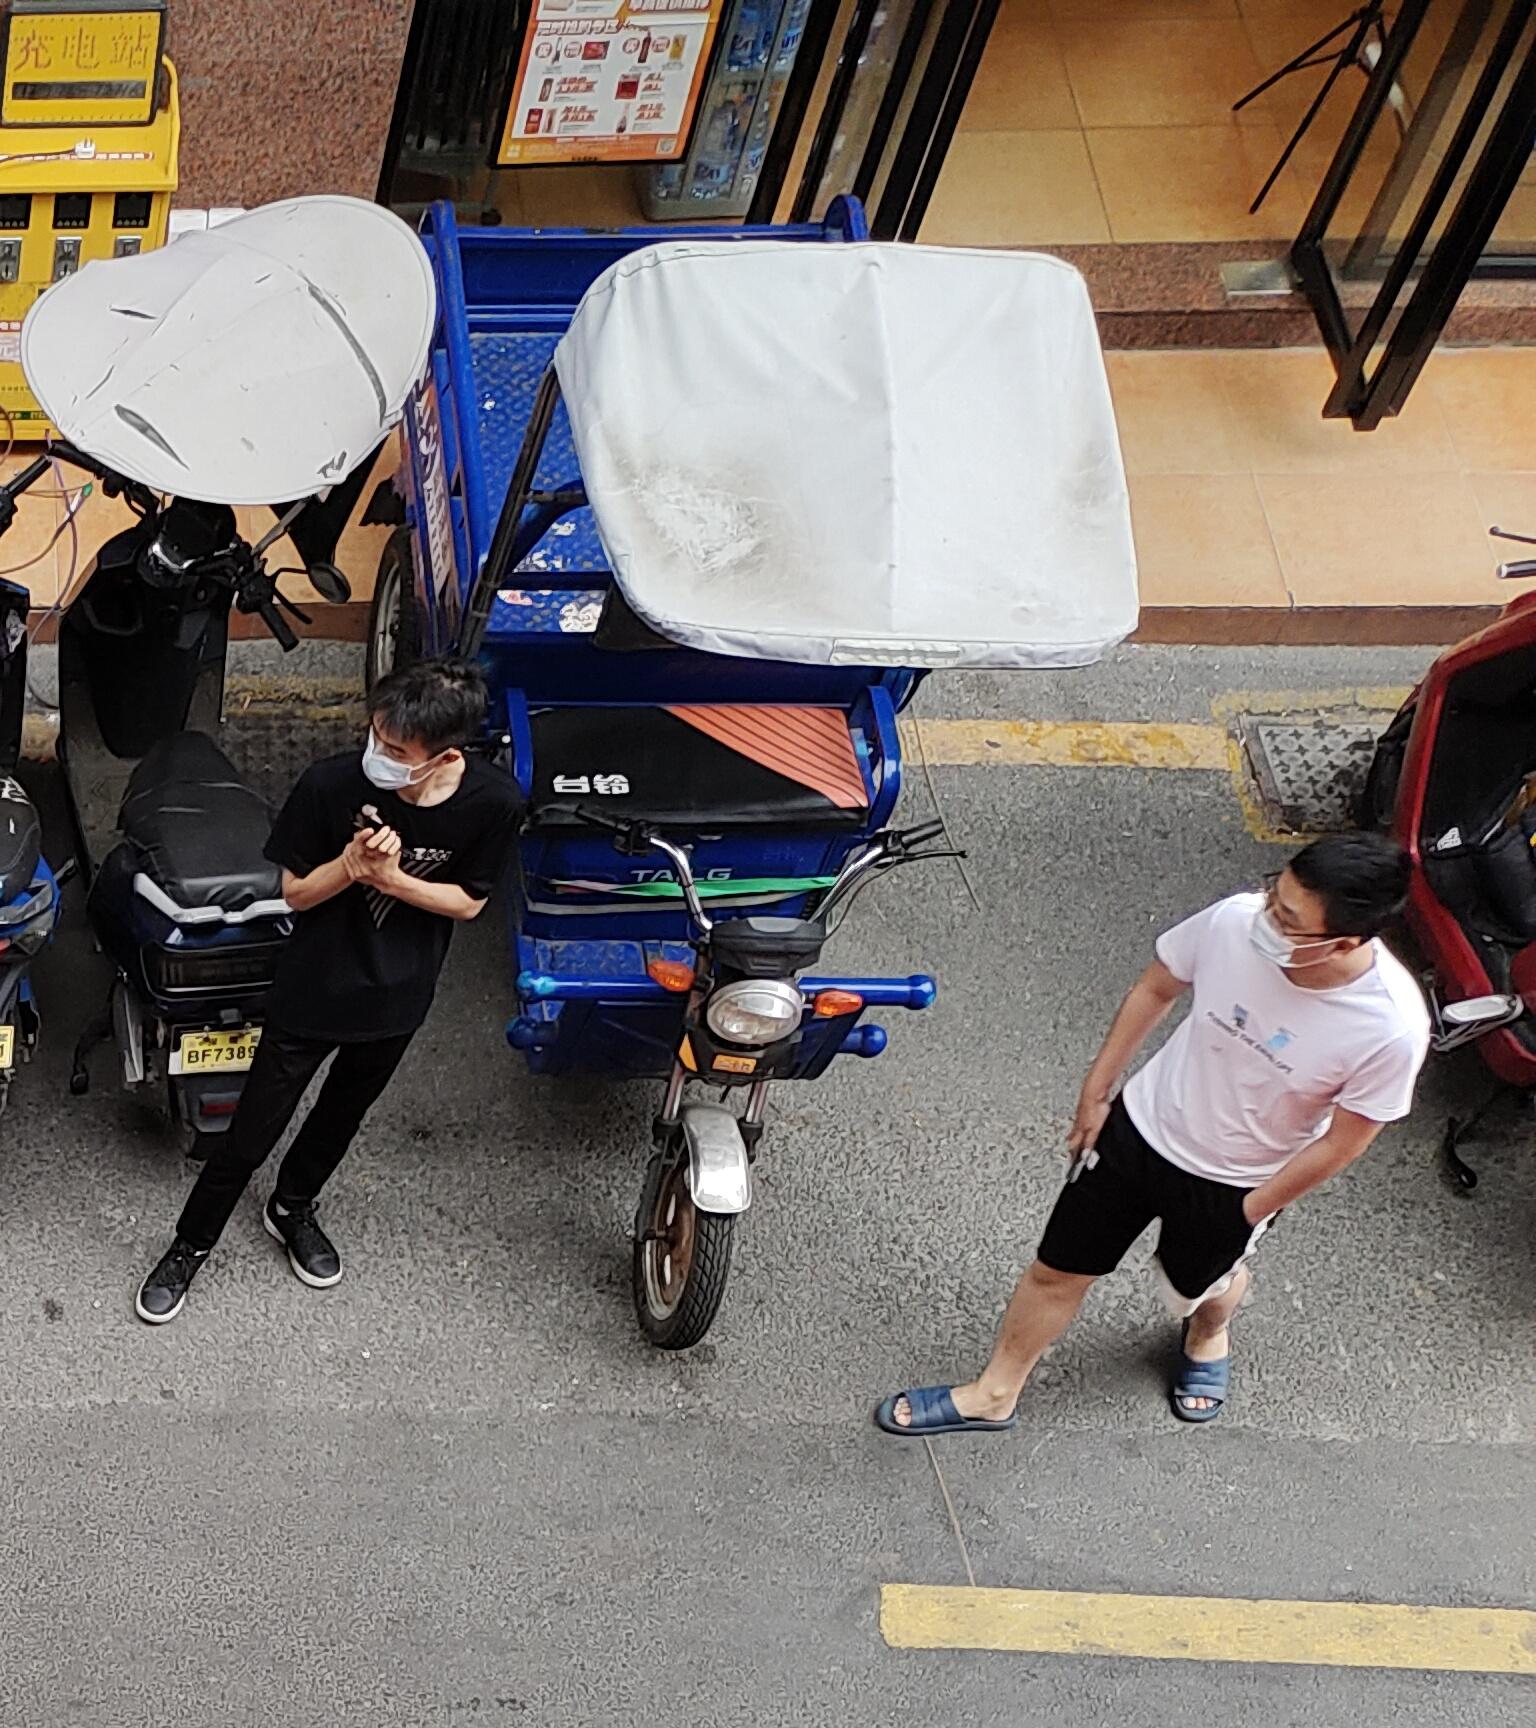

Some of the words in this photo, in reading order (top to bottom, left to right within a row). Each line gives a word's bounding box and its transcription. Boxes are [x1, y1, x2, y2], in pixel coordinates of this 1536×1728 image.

[15, 24, 152, 71] 充电站
[553, 774, 630, 794] 台铃
[630, 868, 732, 882] TAG
